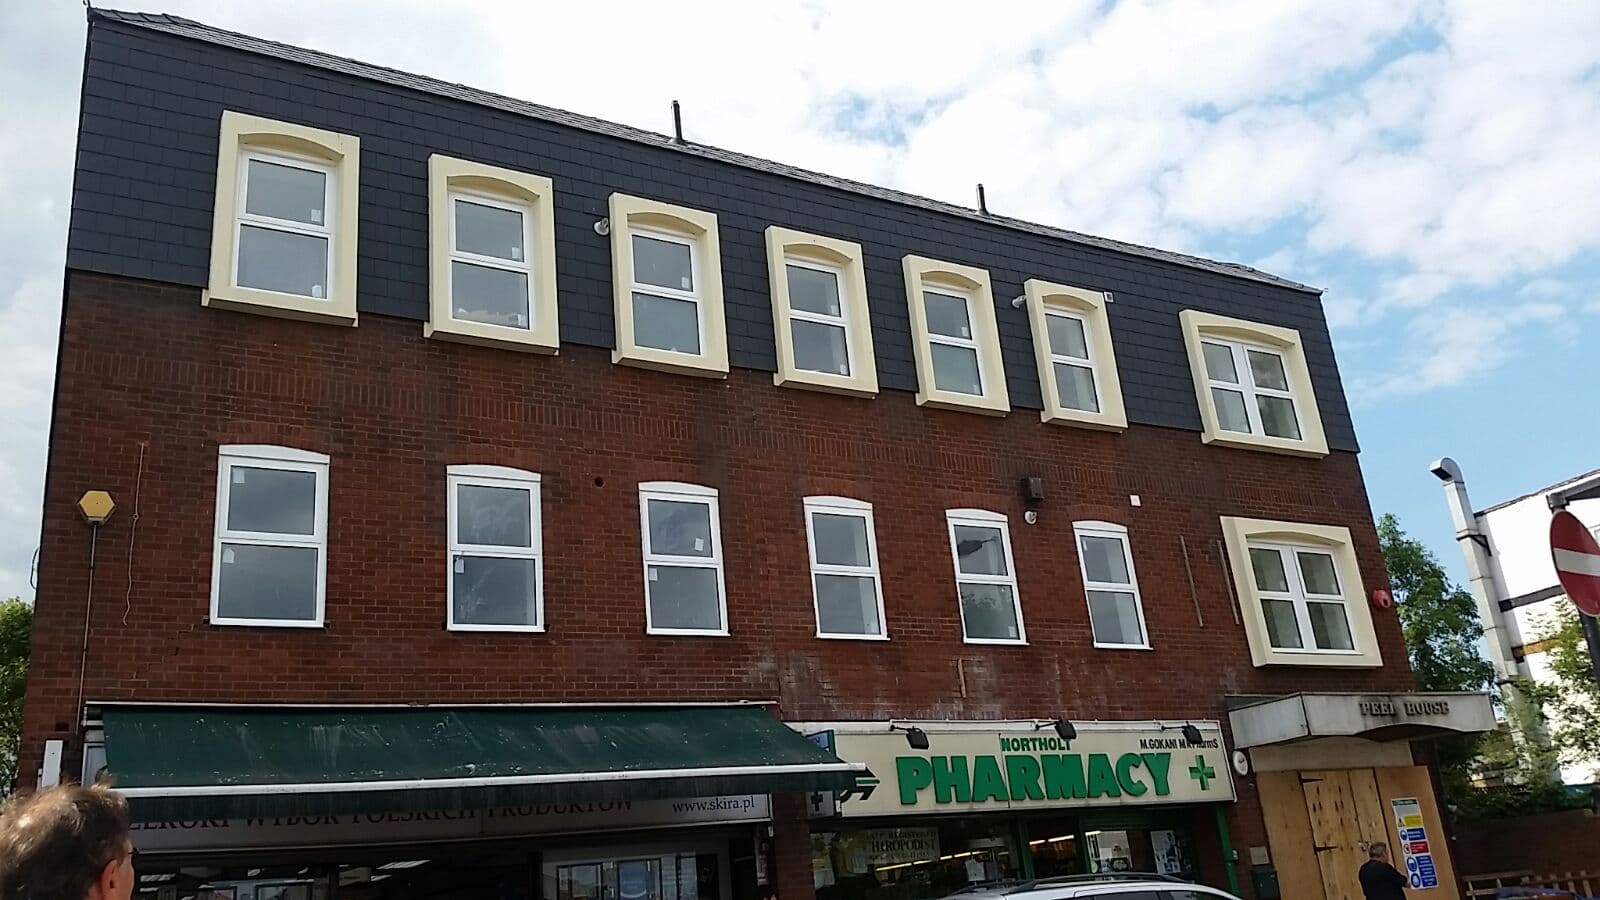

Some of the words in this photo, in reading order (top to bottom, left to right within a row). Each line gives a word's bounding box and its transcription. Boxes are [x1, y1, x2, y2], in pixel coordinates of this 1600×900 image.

[1360, 701, 1396, 716] PEEL
[1404, 700, 1450, 716] HOUSE
[1000, 737, 1071, 752] NORTHOLT
[896, 752, 1171, 805] PHARMACY
[672, 795, 755, 814] www.skira.pl
